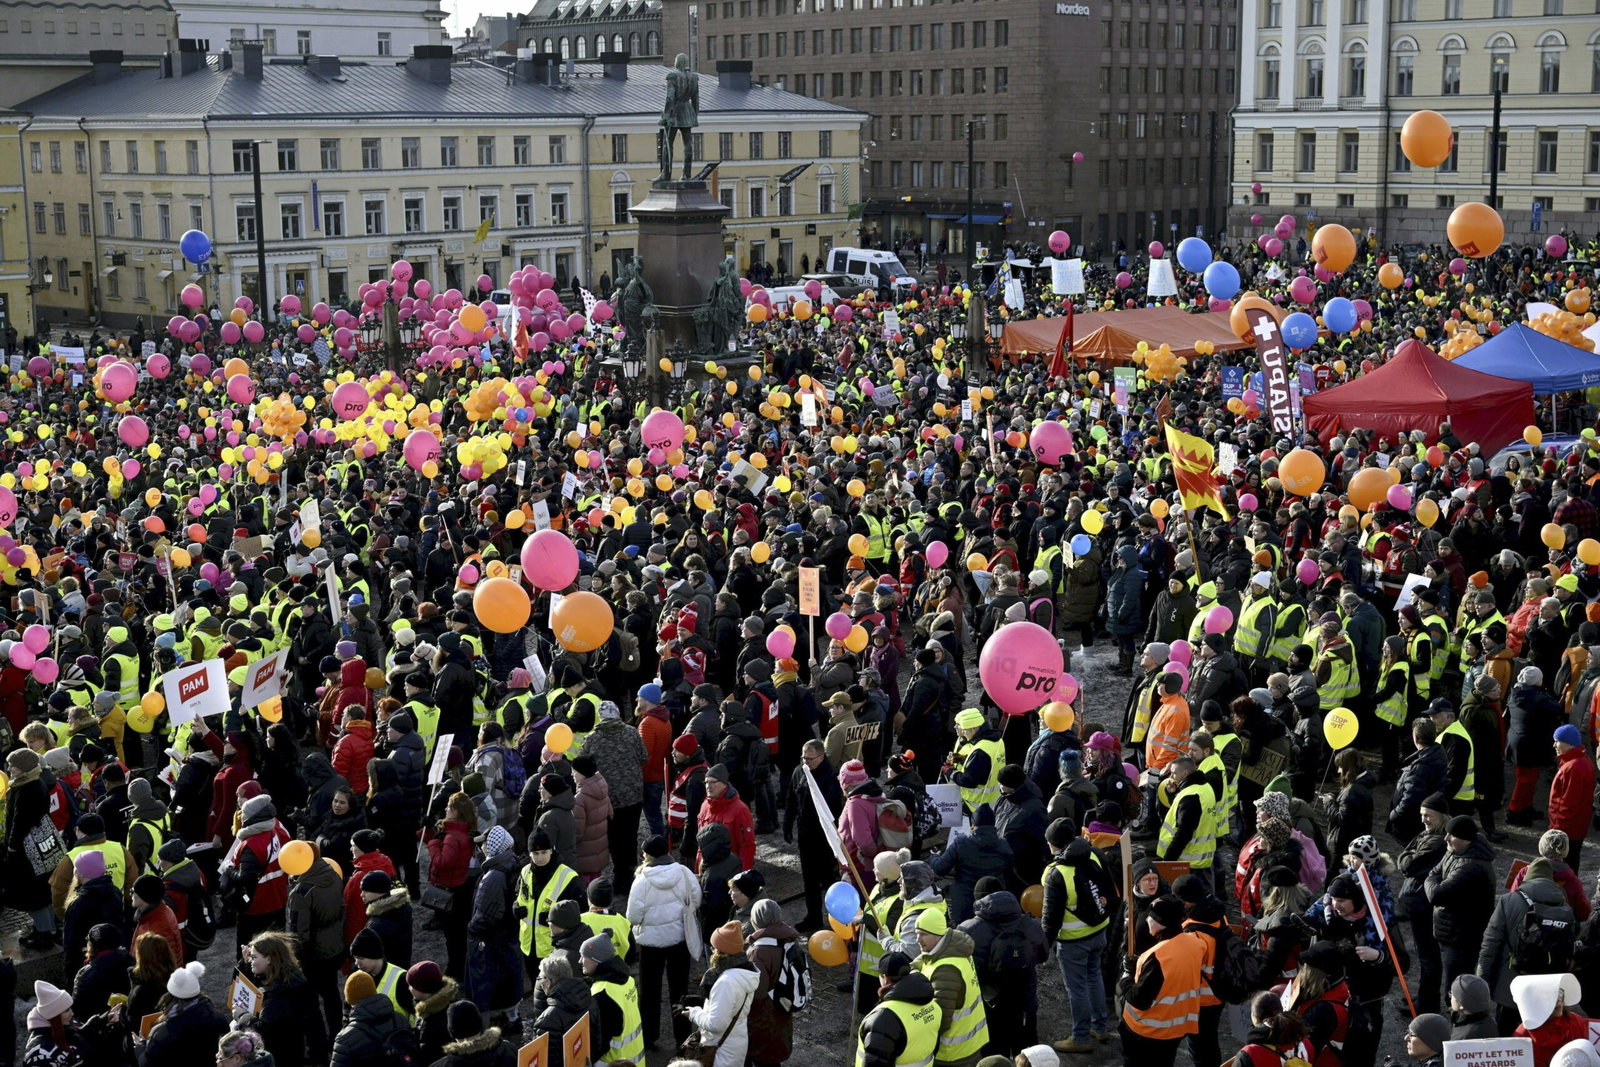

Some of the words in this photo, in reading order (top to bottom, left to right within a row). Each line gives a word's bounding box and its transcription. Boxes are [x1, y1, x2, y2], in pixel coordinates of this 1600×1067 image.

[1056, 3, 1090, 16] Nordea
[345, 402, 364, 412] pro
[650, 439, 672, 452] pro
[257, 664, 274, 683] PAM
[182, 676, 205, 696] PAM
[1015, 671, 1056, 693] pro
[1332, 715, 1348, 723] STOP
[38, 835, 56, 853] UFF
[1089, 880, 1105, 914] ellesse
[1542, 919, 1568, 928] SHOT
[912, 1005, 935, 1021] Teollisuus
[1455, 1052, 1483, 1060] DON'T
[1485, 1051, 1503, 1059] LET
[1505, 1049, 1524, 1058] THE
